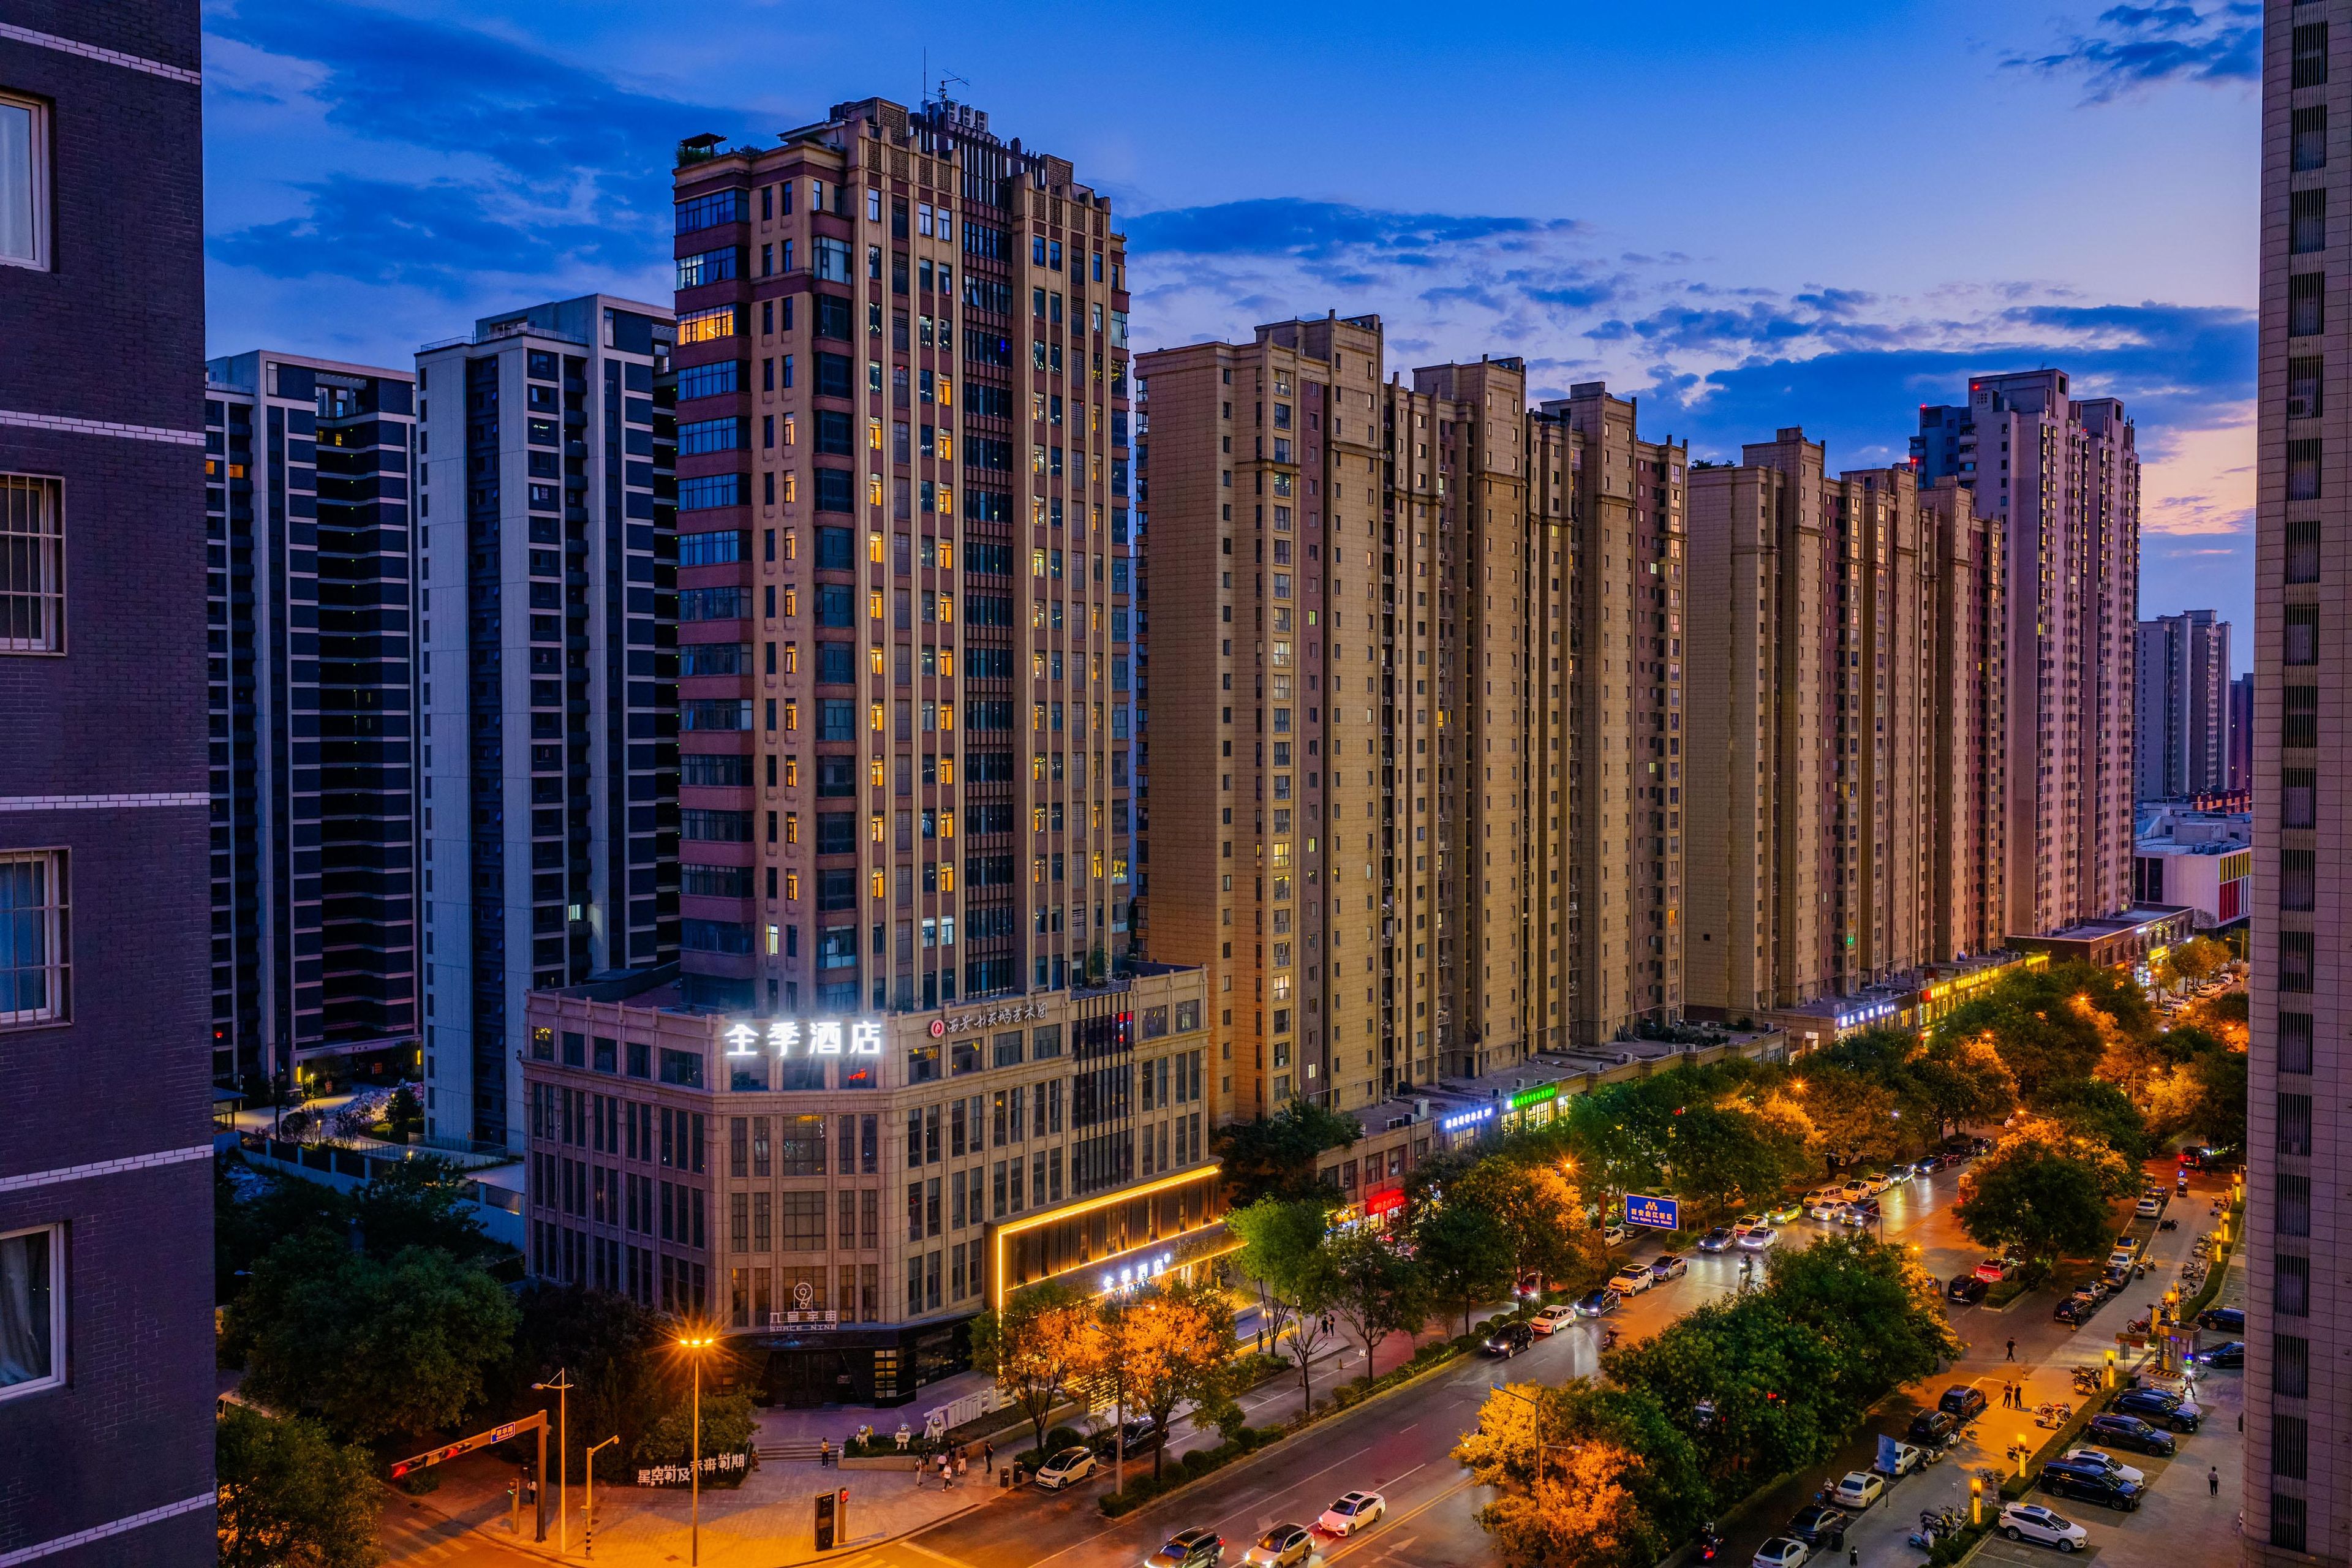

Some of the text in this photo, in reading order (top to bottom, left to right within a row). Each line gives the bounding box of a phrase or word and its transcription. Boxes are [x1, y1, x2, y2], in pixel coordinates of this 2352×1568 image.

[725, 1021, 881, 1056] 全季酒店
[1631, 1208, 1673, 1221] 西安曲江新区
[1103, 1259, 1164, 1294] 全季酒店
